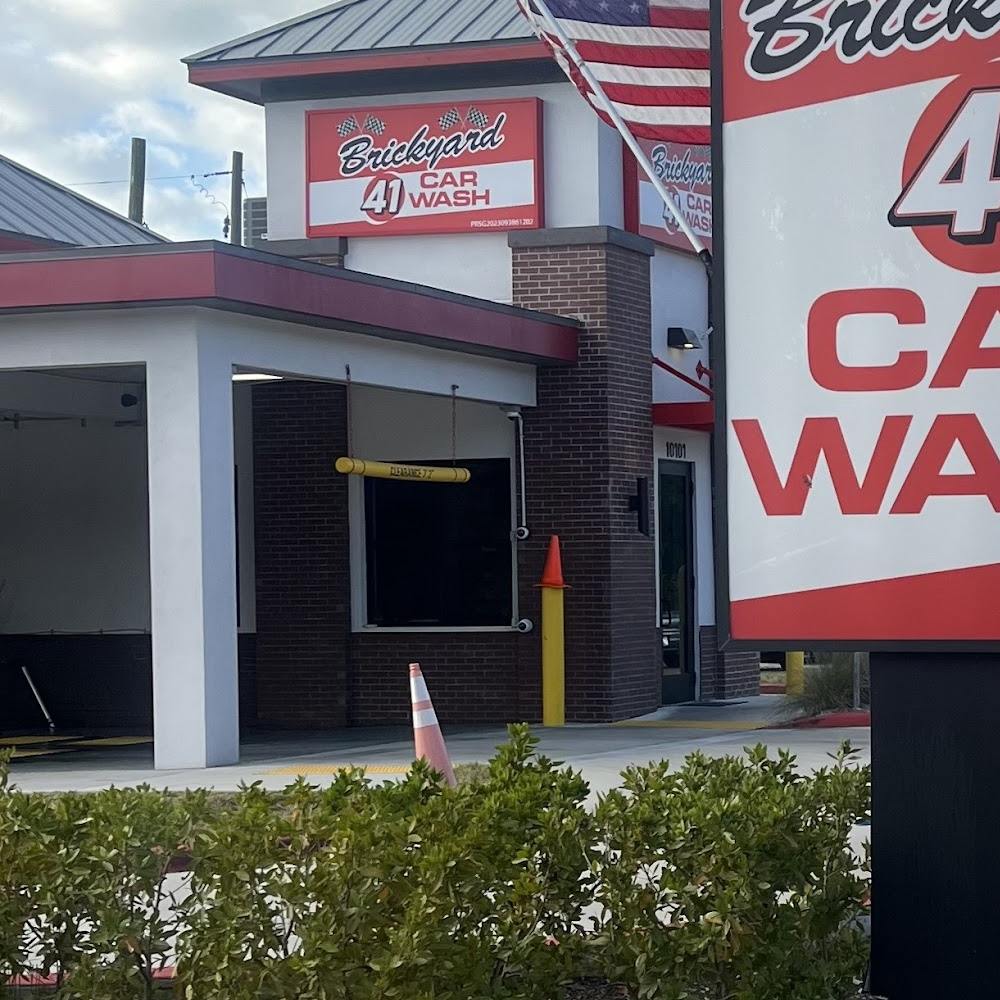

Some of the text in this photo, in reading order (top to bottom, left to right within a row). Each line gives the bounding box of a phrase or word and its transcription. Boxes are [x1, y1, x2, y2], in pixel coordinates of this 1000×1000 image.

[338, 112, 507, 176] Brickyard
[651, 144, 711, 193] Brickyar
[420, 171, 478, 190] CAR
[361, 178, 404, 215] 41
[409, 189, 490, 209] WASH
[666, 441, 686, 459] 10101
[390, 466, 421, 478] CLEARANCE
